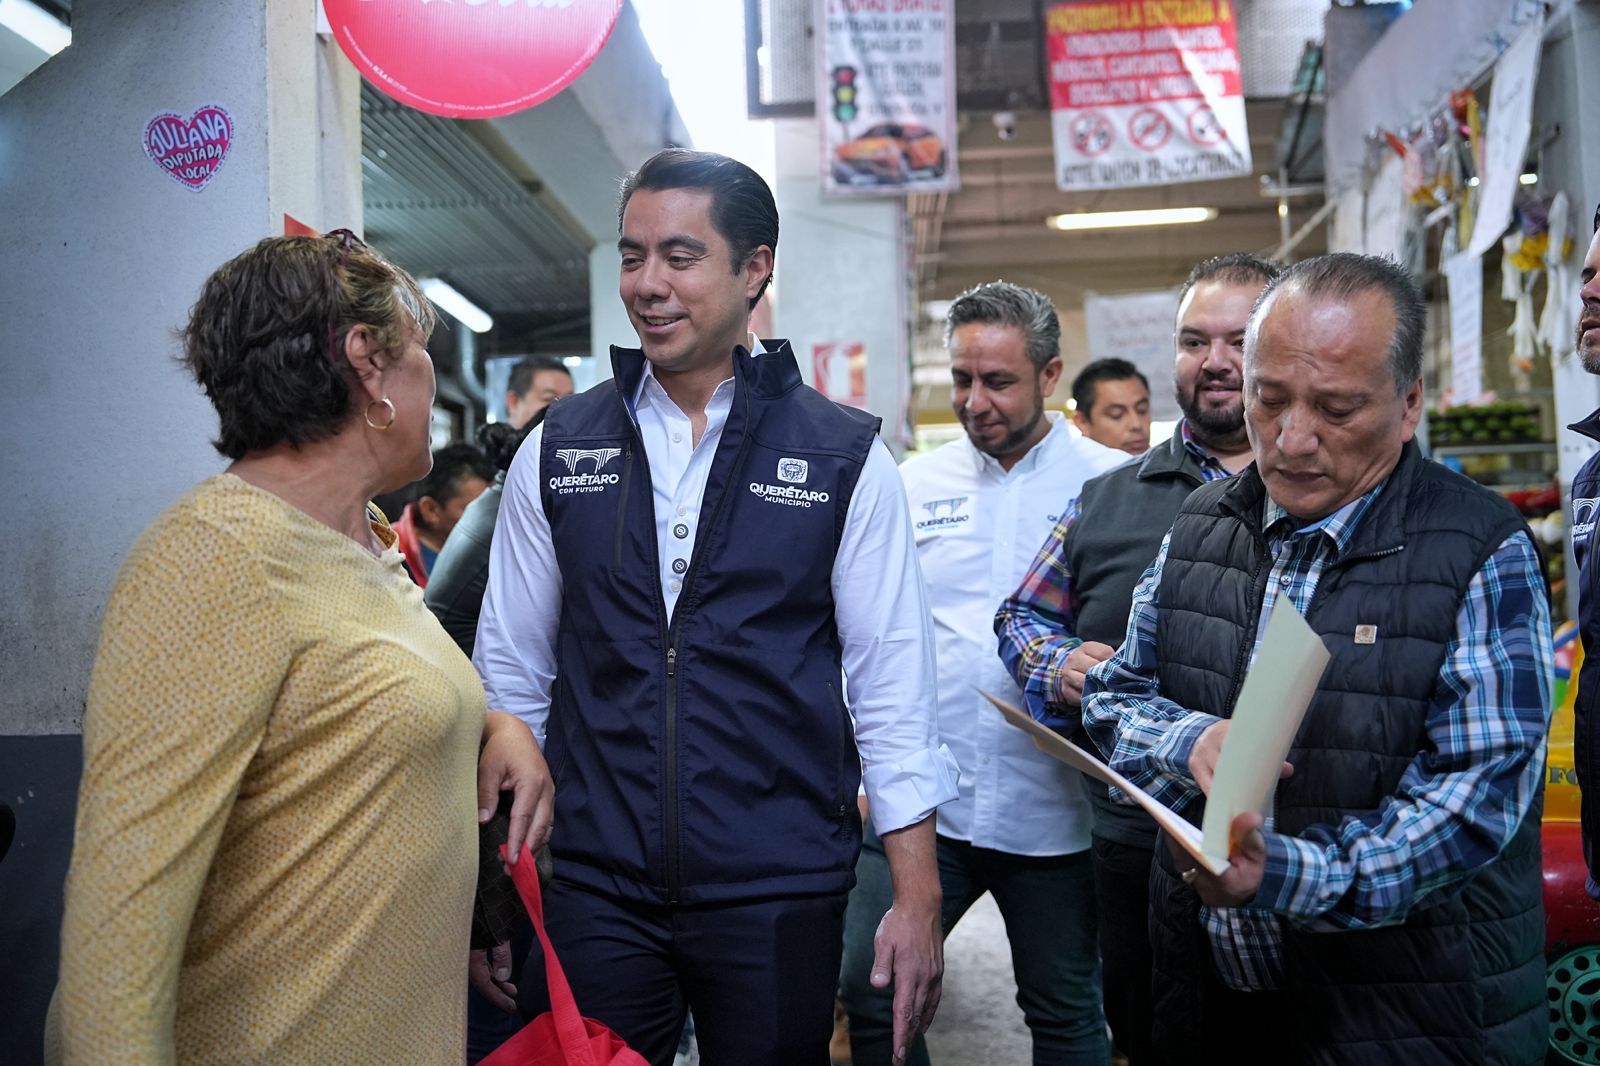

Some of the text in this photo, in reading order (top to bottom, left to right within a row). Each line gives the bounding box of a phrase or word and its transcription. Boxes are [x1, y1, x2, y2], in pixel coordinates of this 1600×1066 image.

[150, 112, 229, 159] JULIANA
[162, 143, 223, 170] DIPUTADA
[549, 473, 620, 490] QUERÉTARO
[559, 485, 605, 495] CON FUTURO
[749, 482, 830, 503] QUERÉTARO
[764, 495, 812, 508] MUNICIPIO
